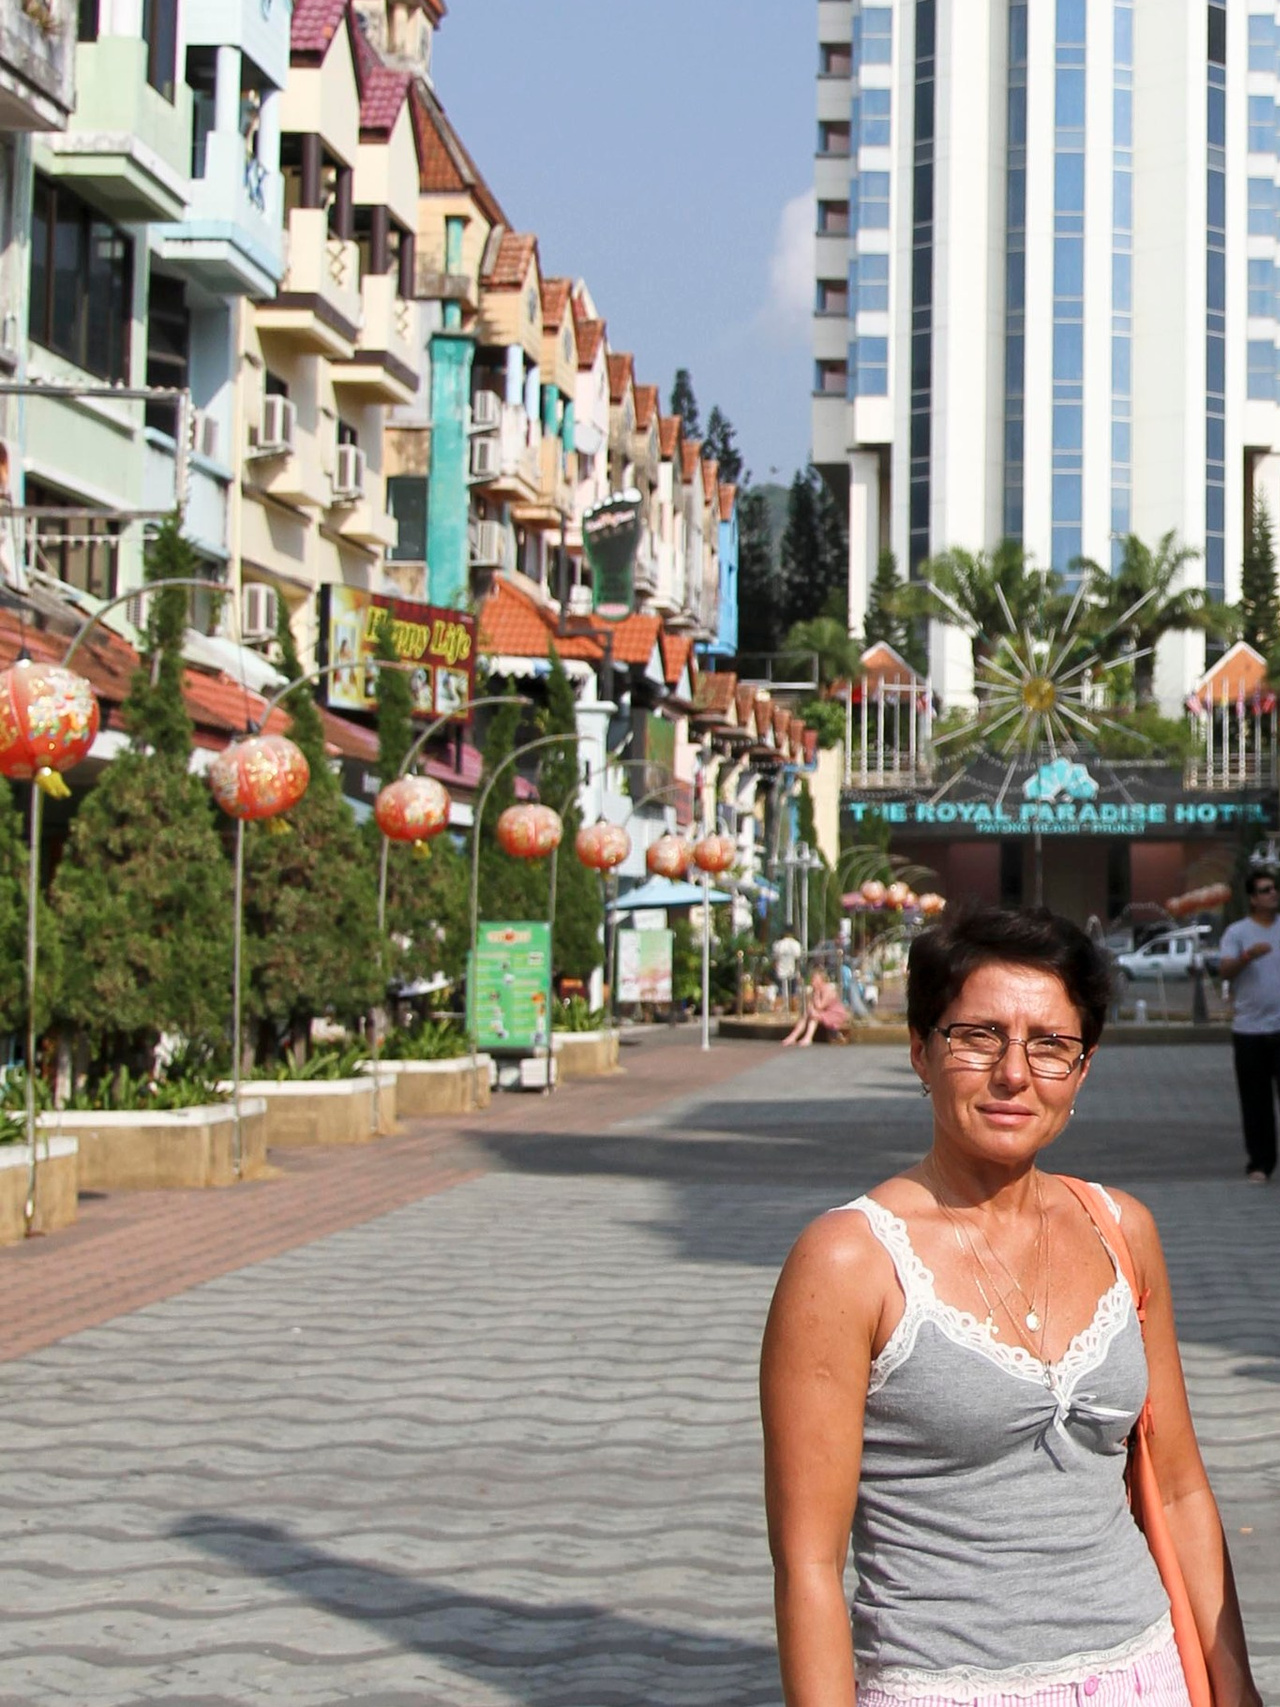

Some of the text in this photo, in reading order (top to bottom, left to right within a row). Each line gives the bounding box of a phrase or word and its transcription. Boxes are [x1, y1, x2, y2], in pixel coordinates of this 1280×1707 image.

[430, 619, 472, 665] Life
[916, 803, 1012, 822] ROYAL
[1020, 803, 1167, 822] PARADISE
